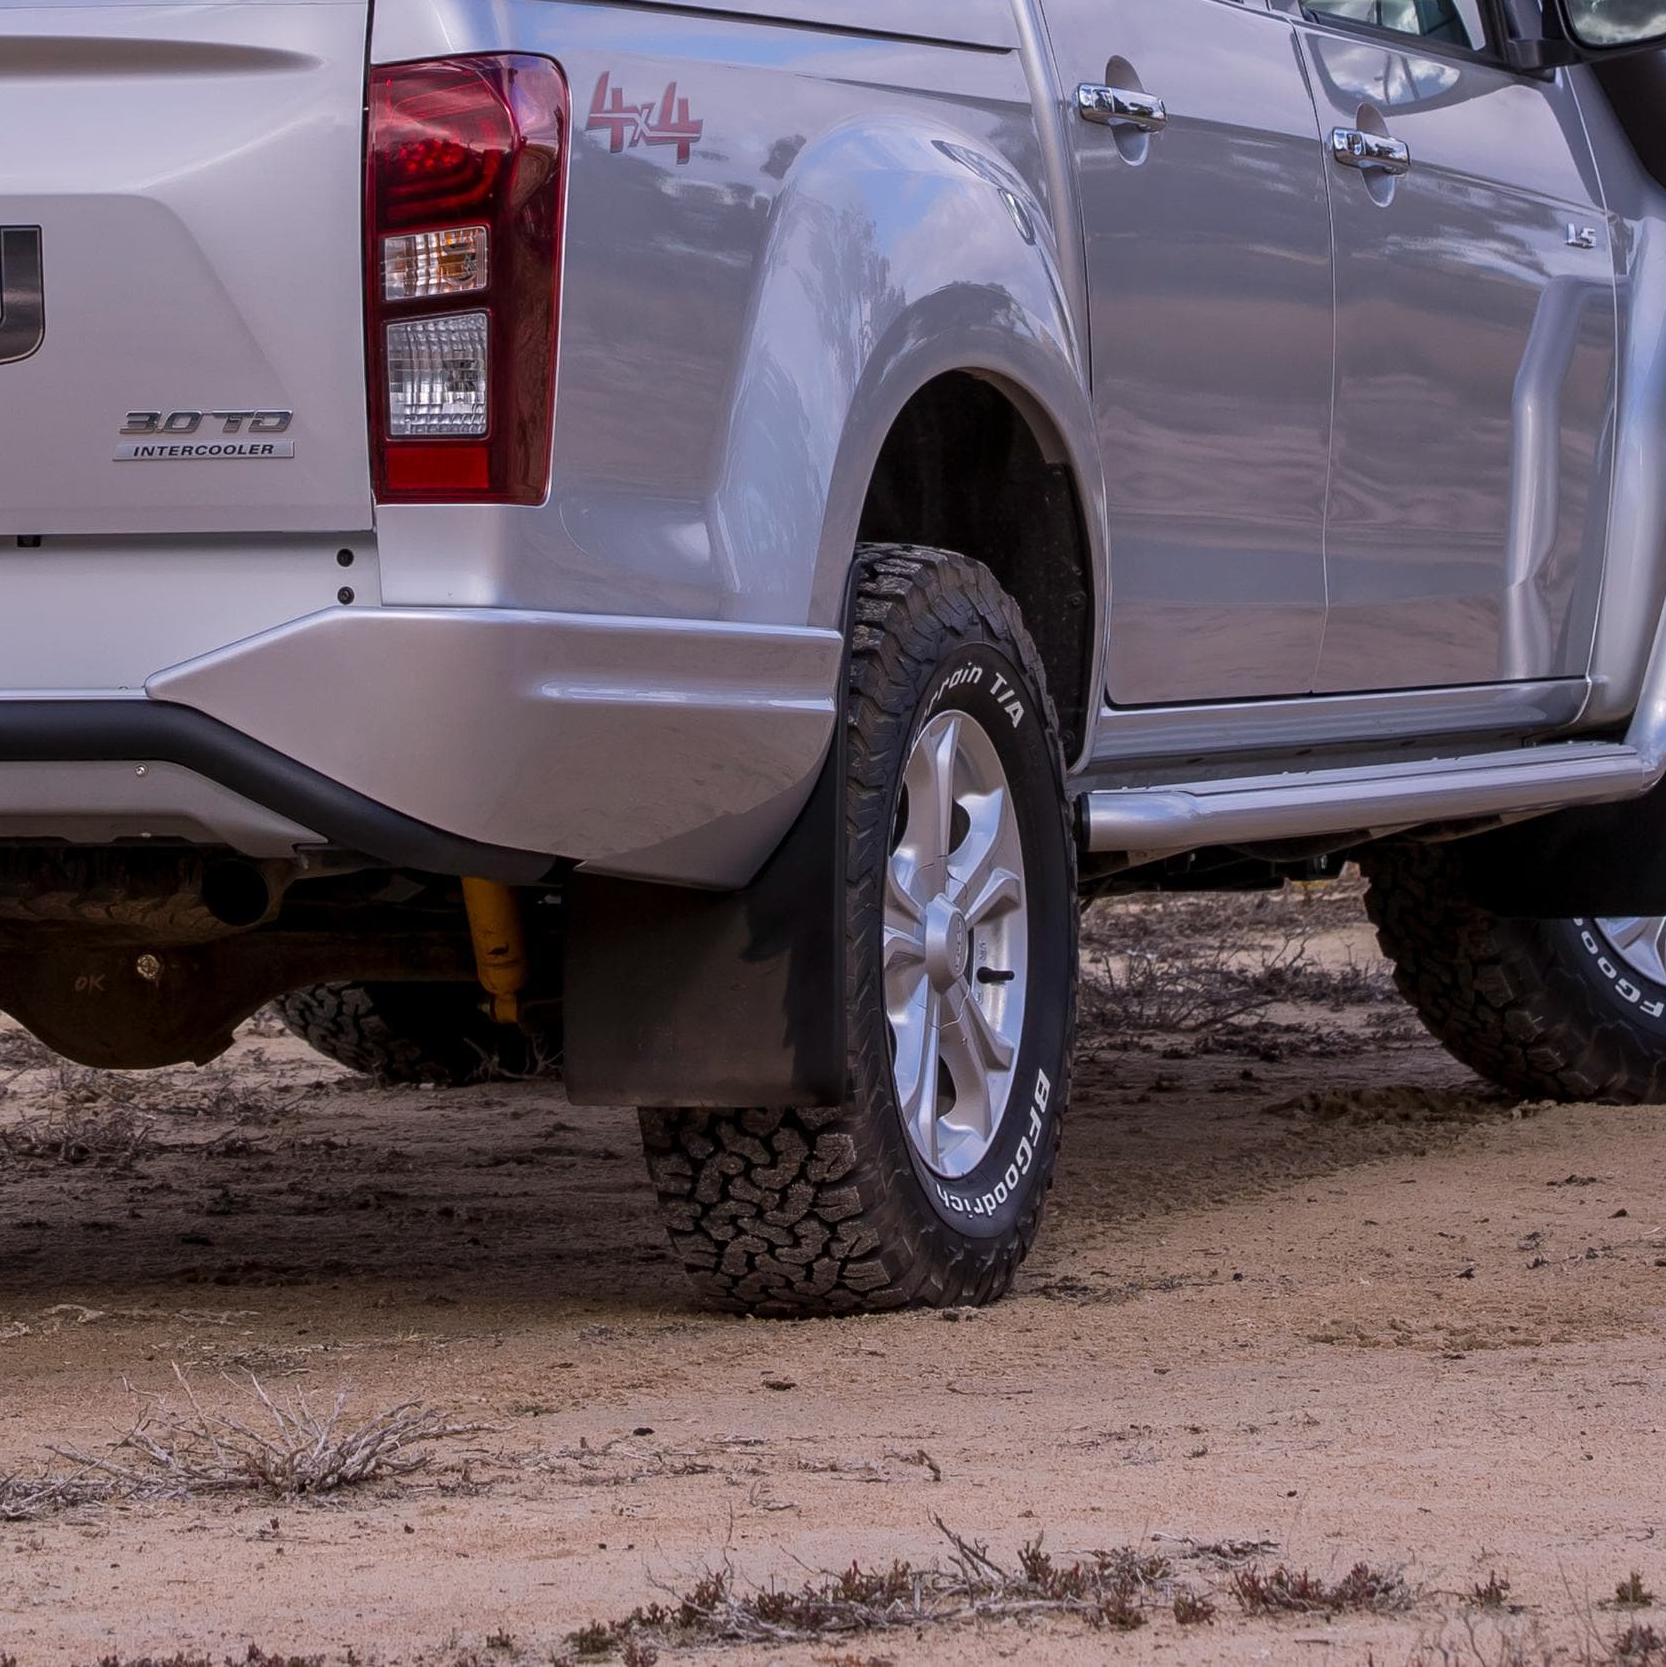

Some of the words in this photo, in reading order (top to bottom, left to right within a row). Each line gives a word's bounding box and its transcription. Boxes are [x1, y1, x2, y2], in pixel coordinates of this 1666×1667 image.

[212, 409, 293, 433] TD
[132, 444, 275, 457] INTERCOOLER
[989, 672, 1025, 729] T/A
[936, 1068, 1051, 1218] BFGoodrich
